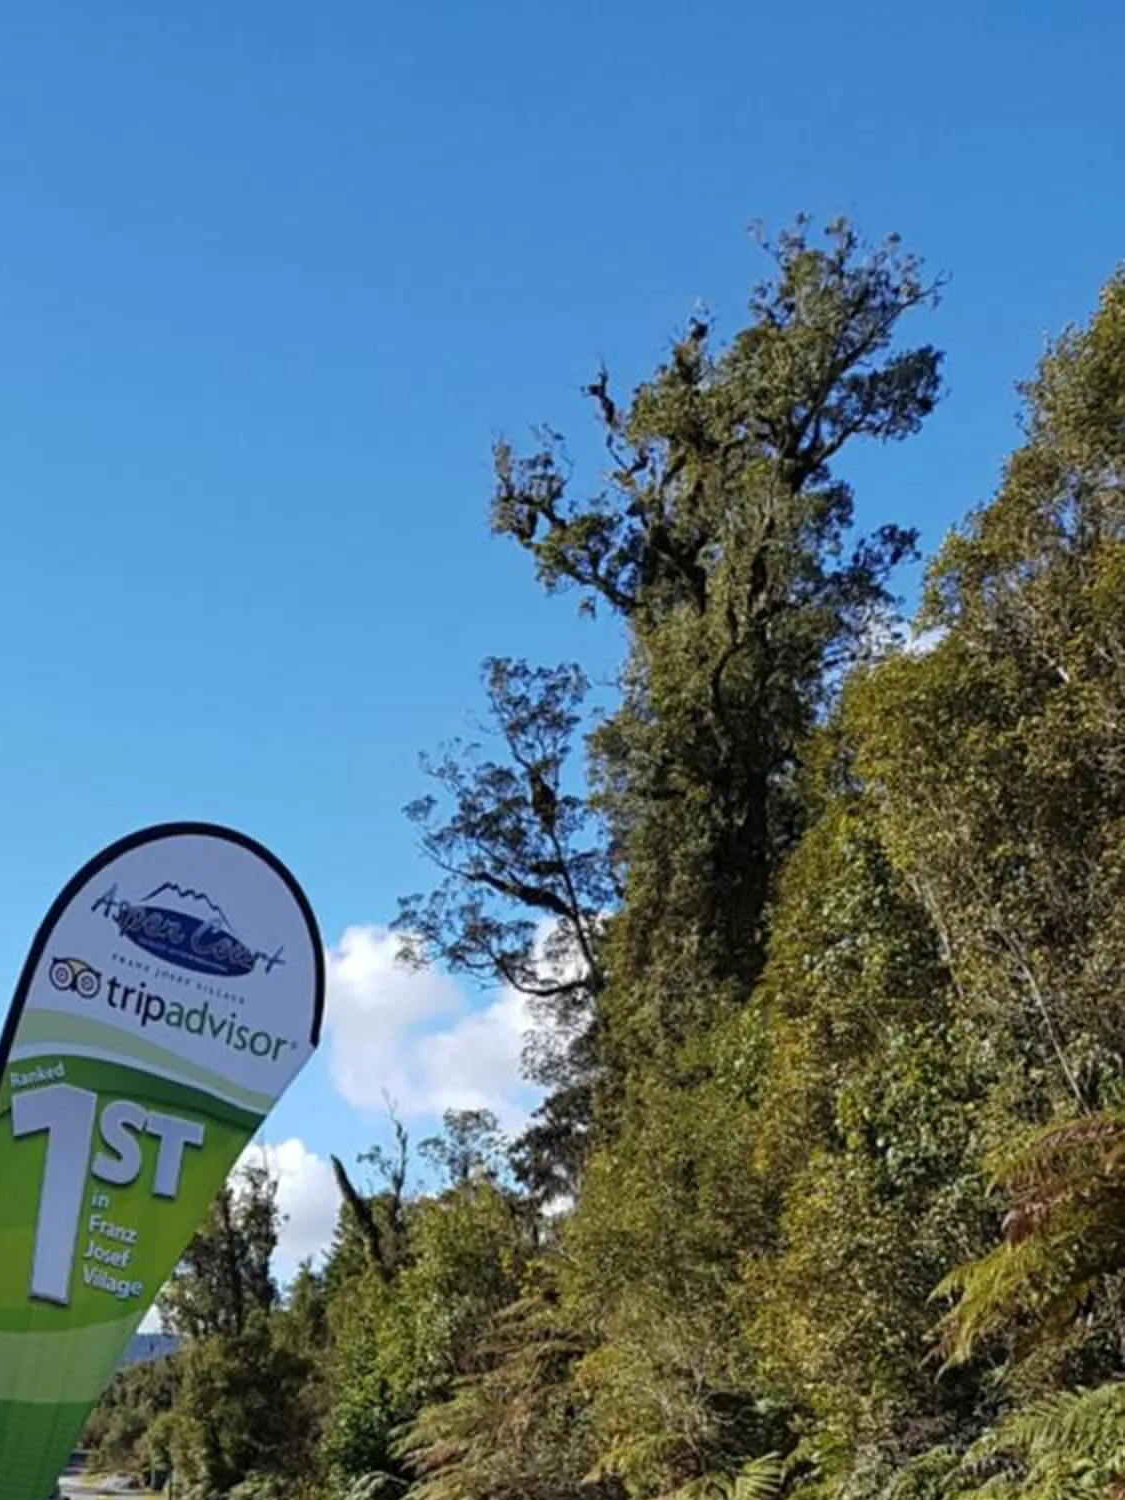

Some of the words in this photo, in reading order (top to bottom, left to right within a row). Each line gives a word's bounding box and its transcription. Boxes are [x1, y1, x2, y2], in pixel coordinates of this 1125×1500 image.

[91, 883, 185, 945] Aspen
[106, 975, 290, 1061] tripadvisor
[10, 1061, 66, 1088] Ranked
[91, 1188, 110, 1209] in
[88, 1213, 138, 1244] Franz
[83, 1241, 132, 1267] Josef
[82, 1266, 143, 1298] Village
